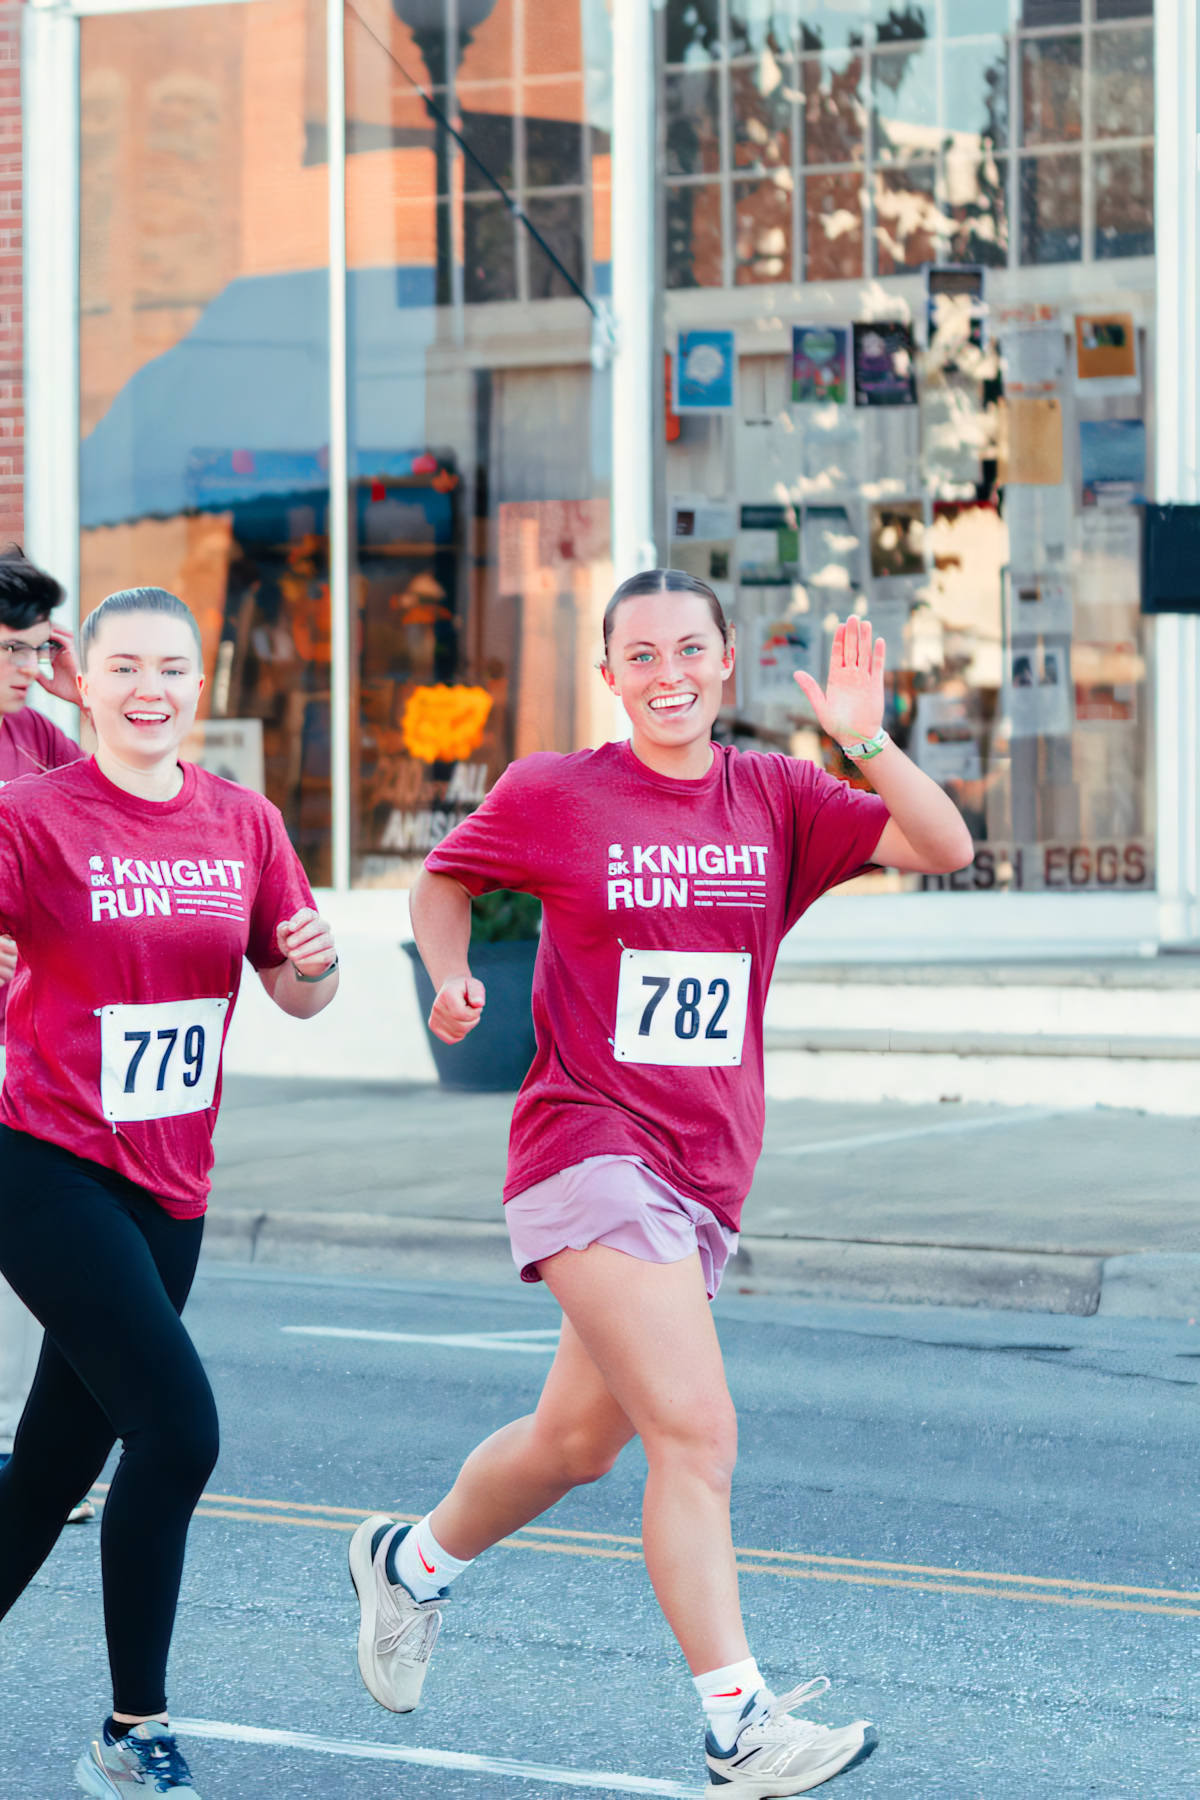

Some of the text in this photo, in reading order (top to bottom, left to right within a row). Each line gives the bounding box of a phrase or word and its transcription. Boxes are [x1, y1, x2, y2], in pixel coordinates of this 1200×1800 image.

[446, 763, 488, 801] ALL
[111, 856, 245, 890] KNIGHT
[632, 844, 768, 875] KNIGHT
[1044, 844, 1146, 887] EGGS
[90, 887, 172, 922] RUN
[607, 878, 688, 910] RUN
[638, 975, 730, 1040] 782
[123, 1024, 205, 1093] 779
